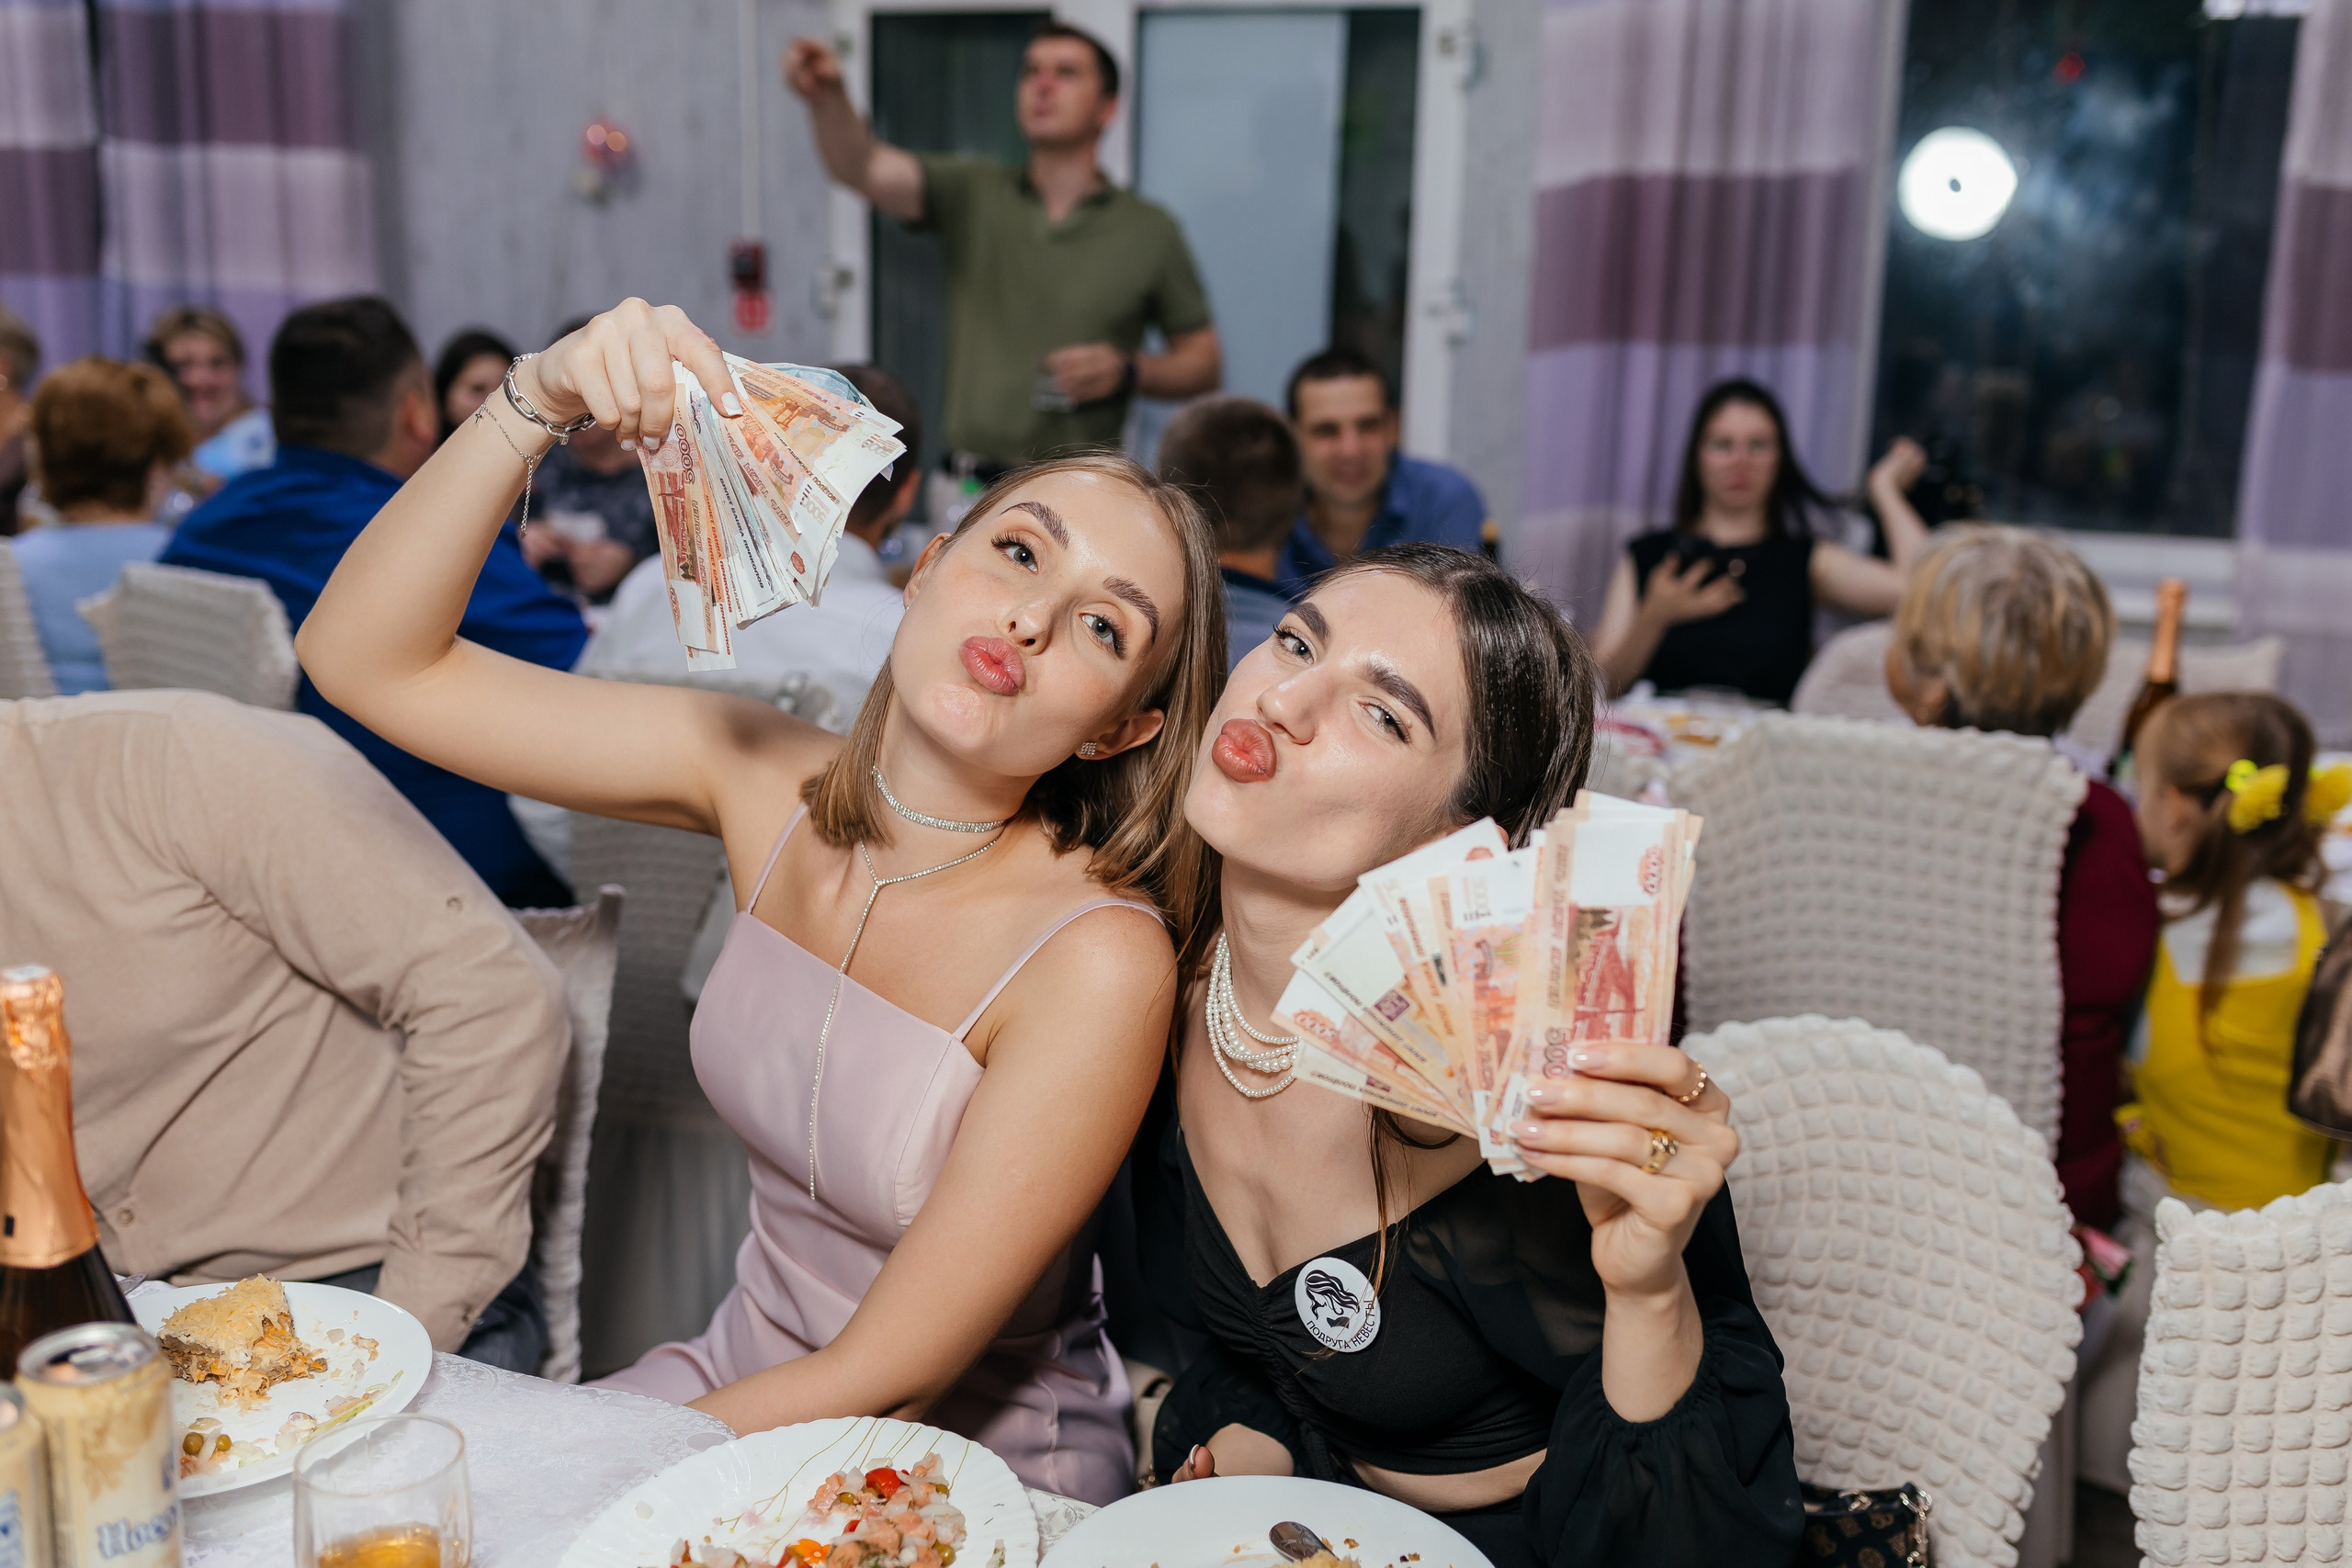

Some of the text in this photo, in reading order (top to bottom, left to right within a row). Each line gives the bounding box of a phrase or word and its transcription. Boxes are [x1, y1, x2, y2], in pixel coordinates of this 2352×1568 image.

[672, 422, 696, 484] 5000
[730, 506, 745, 537] БАНКА
[743, 538, 764, 590] ПРИКОЛОВ
[718, 559, 733, 613] ПРИКОЛОВ
[718, 603, 732, 655] ПРИКОЛОВ
[1542, 1024, 1571, 1080] 500
[1306, 1300, 1375, 1349] ПОДРУГА НЕВЕСТЫ
